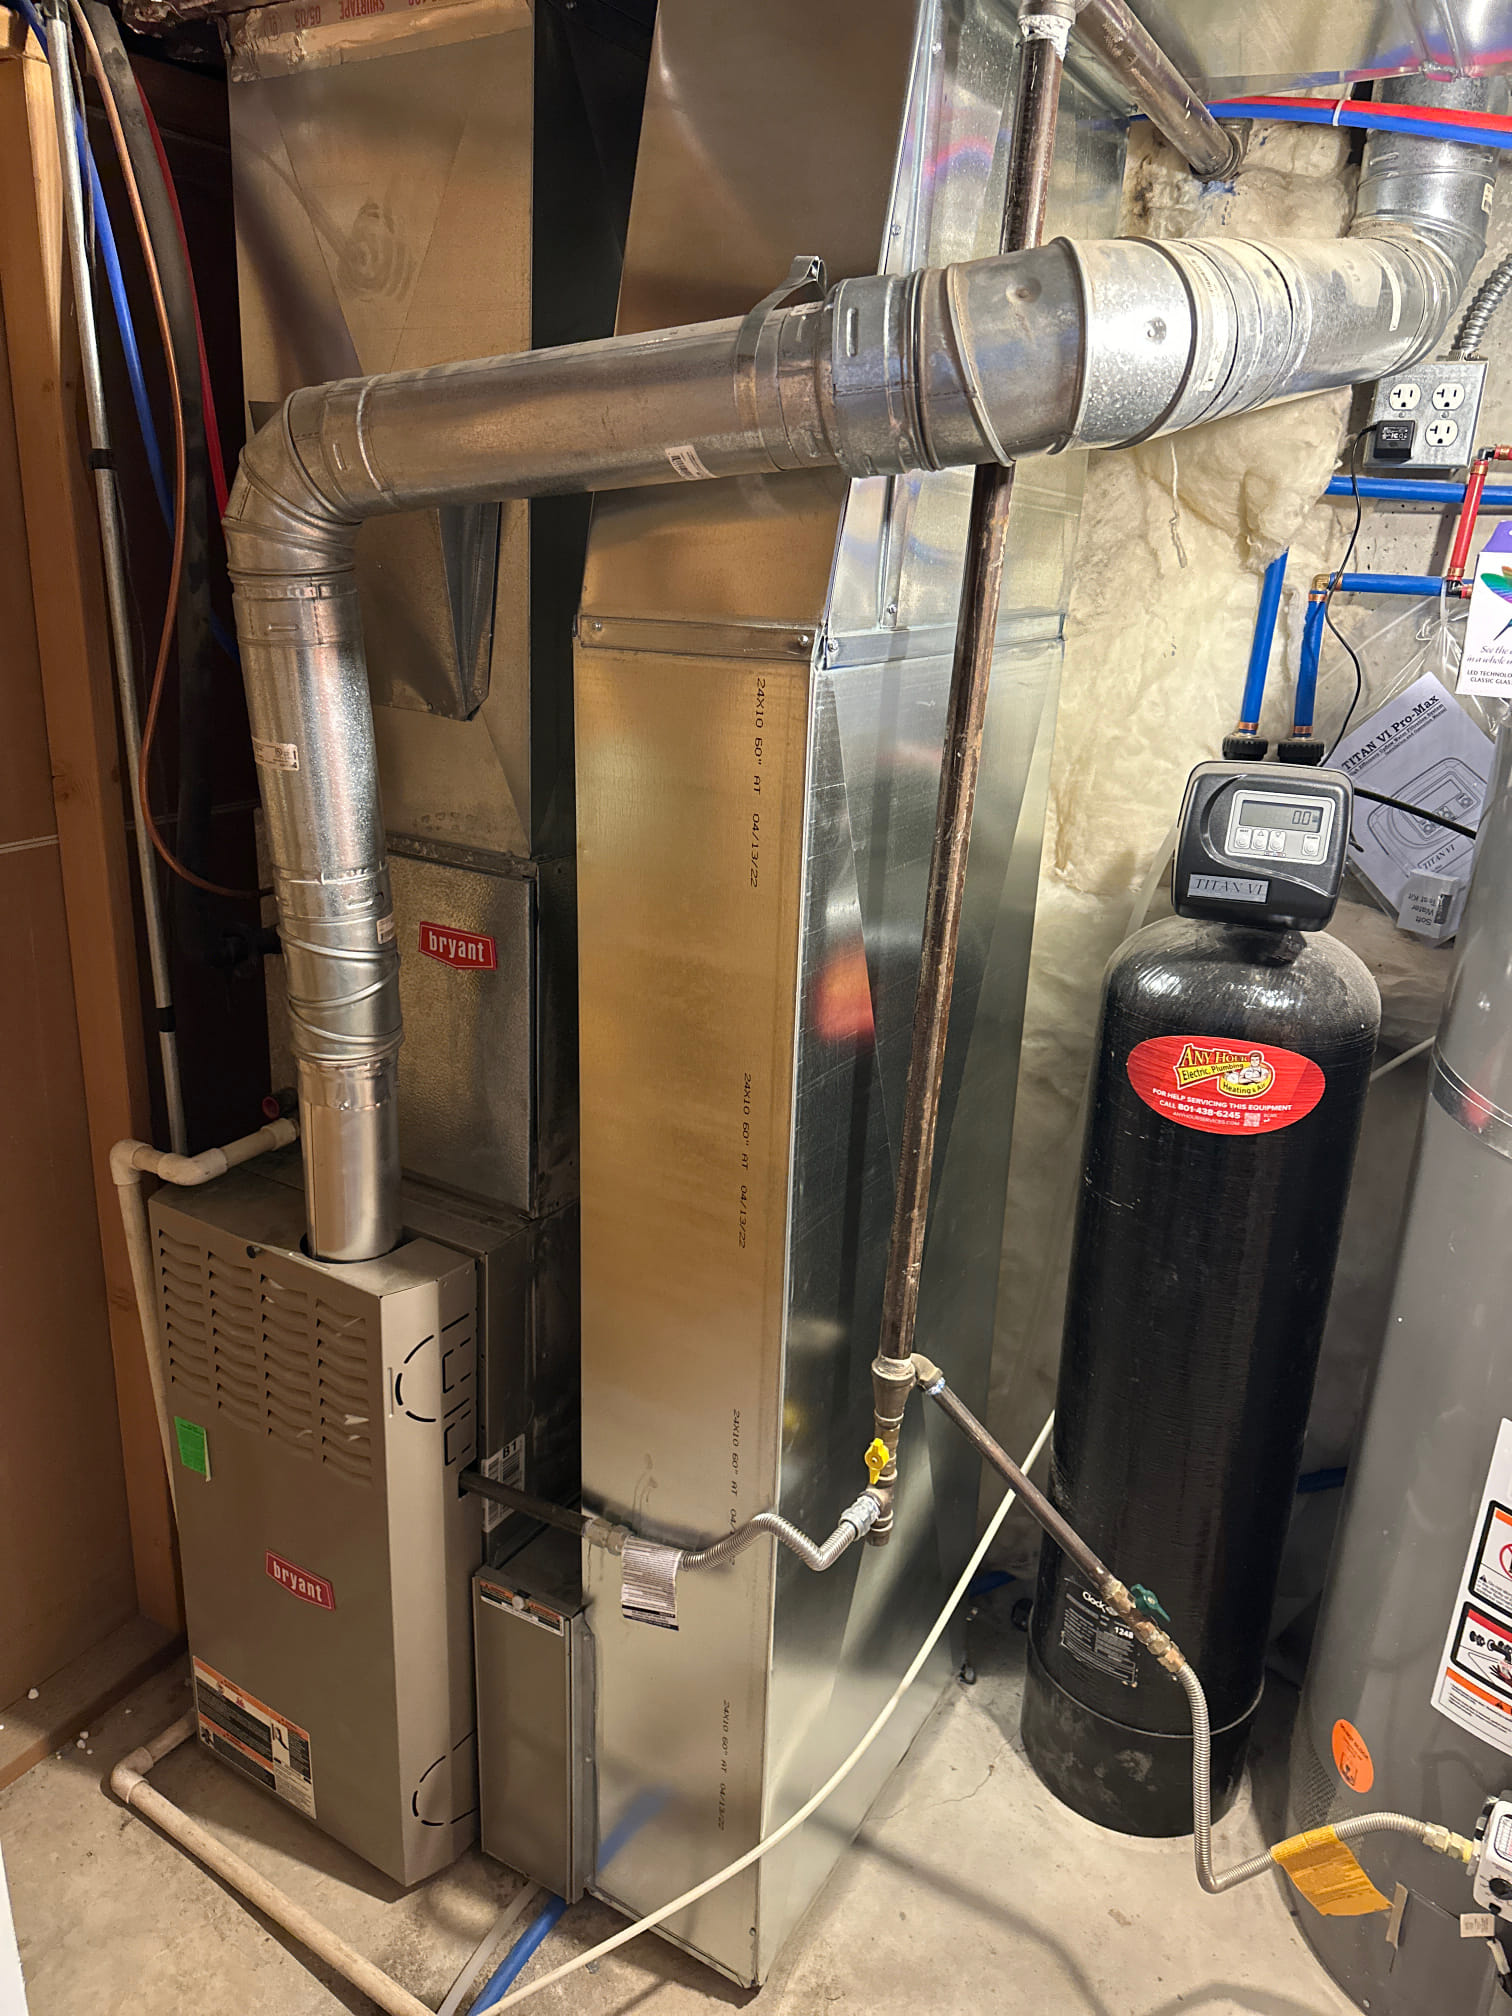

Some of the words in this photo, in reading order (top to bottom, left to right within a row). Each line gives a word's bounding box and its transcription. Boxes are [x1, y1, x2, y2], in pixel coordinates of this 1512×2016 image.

[1470, 676, 1494, 684] CLASSIC
[1495, 678, 1512, 686] GLAS
[755, 677, 766, 729] 24X10
[1341, 741, 1377, 770] TITAN
[1376, 729, 1392, 743] VI
[1390, 695, 1440, 733] Pro-Max
[750, 813, 760, 889] 04/13/22
[1194, 878, 1243, 893] TITAN
[1248, 883, 1264, 895] VI
[1407, 893, 1419, 901] Kit
[1421, 896, 1437, 907] Test
[1411, 905, 1434, 917] Water
[1415, 915, 1433, 926] Soft
[428, 930, 485, 963] bryant
[1181, 1046, 1212, 1067] ANY
[1211, 1063, 1244, 1073] Plumbing
[743, 1072, 752, 1116] 24X10
[1223, 1081, 1252, 1094] Heating
[1256, 1083, 1266, 1092] Air
[1152, 1087, 1169, 1097] FOR
[1169, 1092, 1186, 1101] HELP
[1187, 1096, 1228, 1108] SERVICING
[1229, 1102, 1247, 1110] THIS
[1159, 1099, 1177, 1109] CALL
[1177, 1103, 1241, 1119] 801-438-6245
[738, 1184, 748, 1249] 04/13/22
[732, 1408, 741, 1447] 24X10
[502, 1440, 518, 1460] B1
[273, 1560, 323, 1603] bryant
